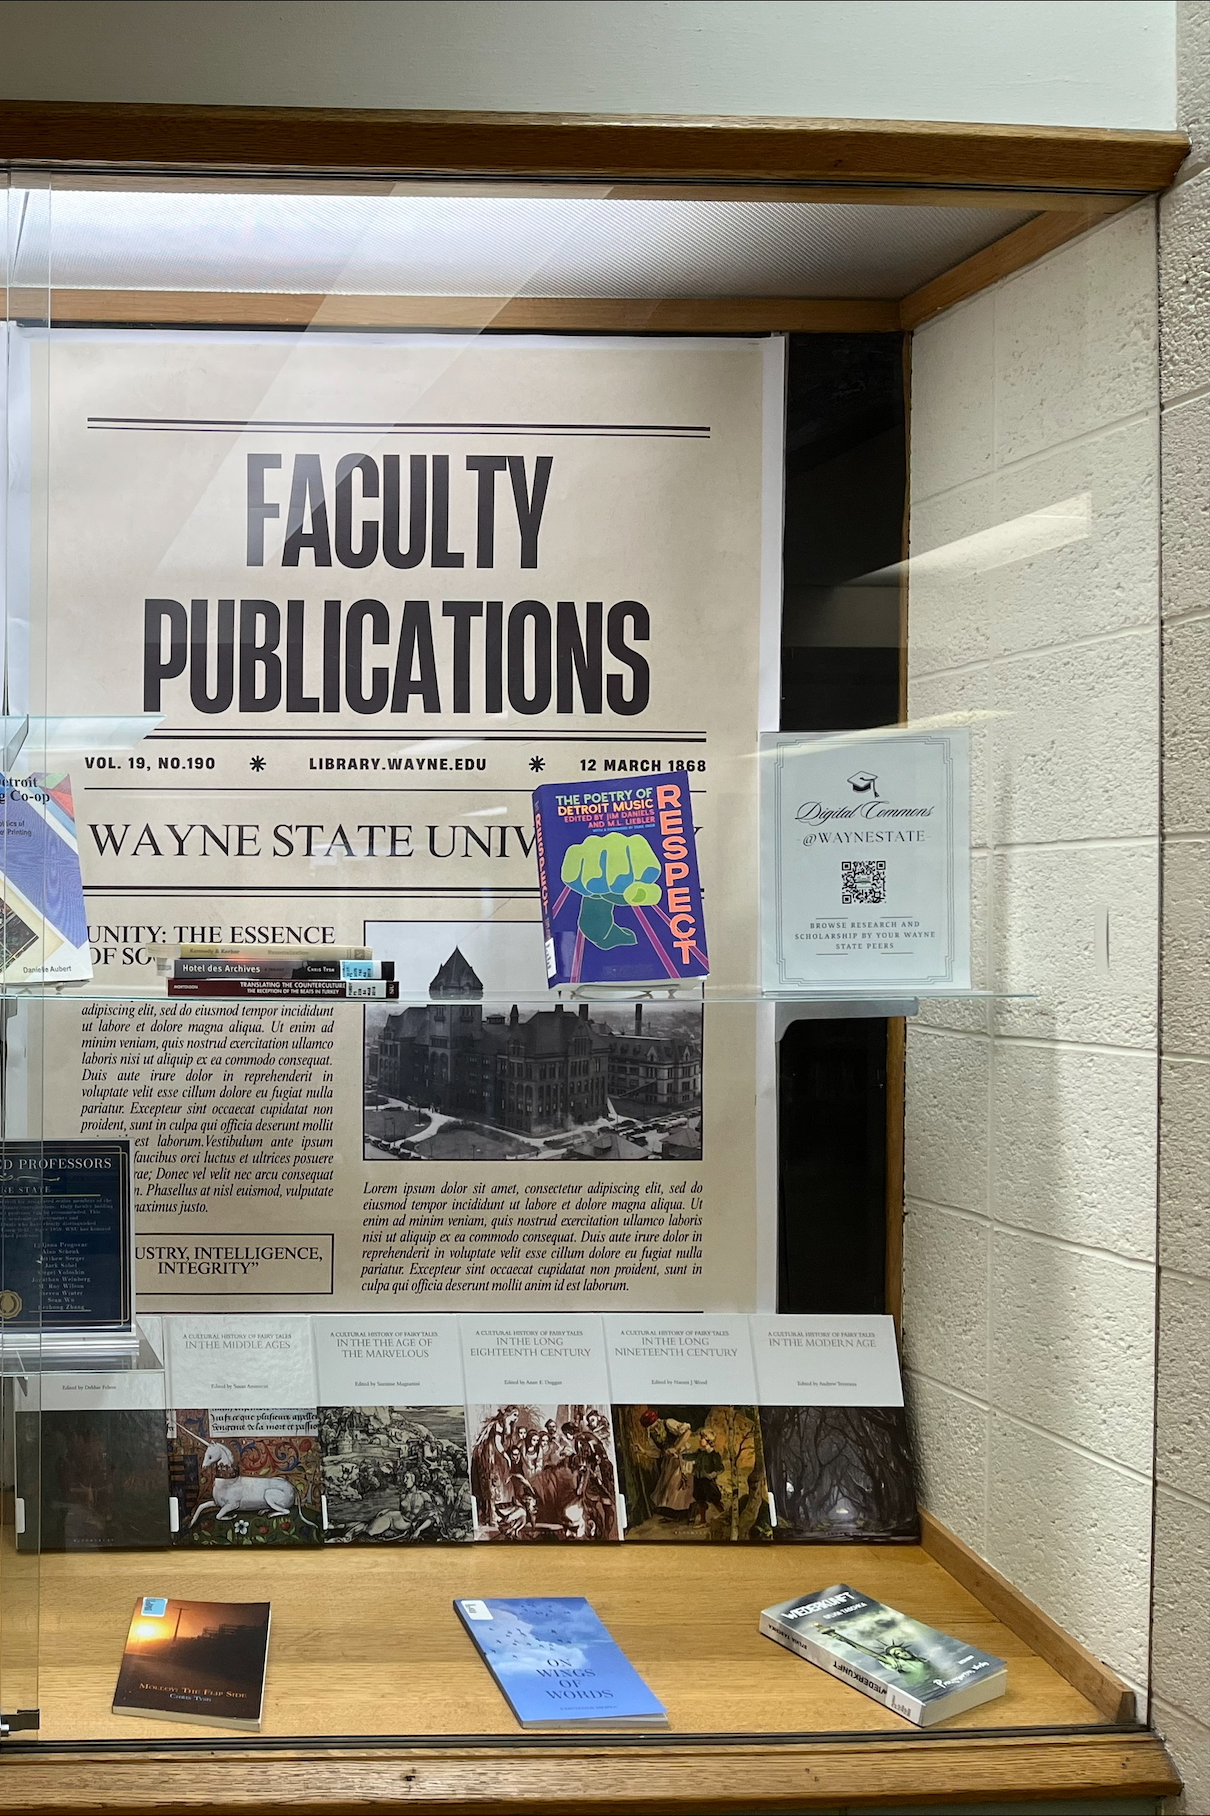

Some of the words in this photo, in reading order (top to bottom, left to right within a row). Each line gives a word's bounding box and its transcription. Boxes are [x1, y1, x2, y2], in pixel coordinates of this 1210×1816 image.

[246, 453, 553, 568] FACULTY
[143, 598, 650, 715] PUBLICATIONS
[84, 756, 121, 771] VOL.
[127, 756, 154, 773] 19,
[158, 756, 216, 770] NO.190
[309, 756, 486, 771] LIBRARY.WAYNE.EDU
[579, 758, 597, 772] 12
[603, 758, 662, 772] MARCH
[667, 758, 706, 772] 1868
[10, 790, 50, 804] Co-op
[556, 795, 581, 806] THE
[584, 789, 632, 804] POETRY
[636, 788, 653, 800] OF
[558, 803, 609, 816] DETROIT
[613, 799, 653, 811] MUSIC
[795, 801, 863, 826] Digital
[860, 801, 935, 819] Commons
[564, 815, 592, 823] EDITED
[606, 812, 619, 820] JIM
[622, 809, 655, 818] DANIELS
[88, 823, 261, 857] WAYNE
[272, 824, 414, 857] STATE
[803, 830, 925, 846] @WAYNESTATE
[656, 784, 697, 965] RESPECT
[86, 926, 167, 945] UNITY:
[173, 926, 223, 944] THE
[230, 926, 335, 945] ESSENCE
[183, 964, 205, 972] Hotel
[225, 965, 261, 973] Archives
[82, 1022, 93, 1032] ut
[98, 1021, 130, 1032] labore
[136, 1022, 145, 1032] et
[150, 1021, 182, 1033] dolore
[188, 1022, 223, 1036] magna
[229, 1020, 265, 1036] aliqua.
[18, 1158, 112, 1169] PROFESSORS
[363, 1182, 398, 1195] Lorem
[403, 1182, 435, 1199] ipsum
[441, 1182, 468, 1195] dolor
[473, 1182, 486, 1195] sit
[491, 1183, 519, 1196] amet,
[525, 1184, 583, 1195] consectetur
[587, 1182, 640, 1198] adipiscing
[194, 1247, 323, 1261] INTELLIGENCE,
[805, 1338, 854, 1347] MODERN
[856, 1339, 876, 1348] AGE
[341, 1350, 363, 1358] THE
[366, 1349, 430, 1358] MARVELOUS
[615, 1348, 683, 1357] NINETEENTH
[686, 1348, 738, 1357] CENTURY
[547, 1658, 572, 1667] ON
[536, 1669, 596, 1677] WINGS
[833, 1661, 888, 1696] WIEDERKUNFT
[559, 1679, 581, 1688] OF
[545, 1690, 614, 1699] WORDS
